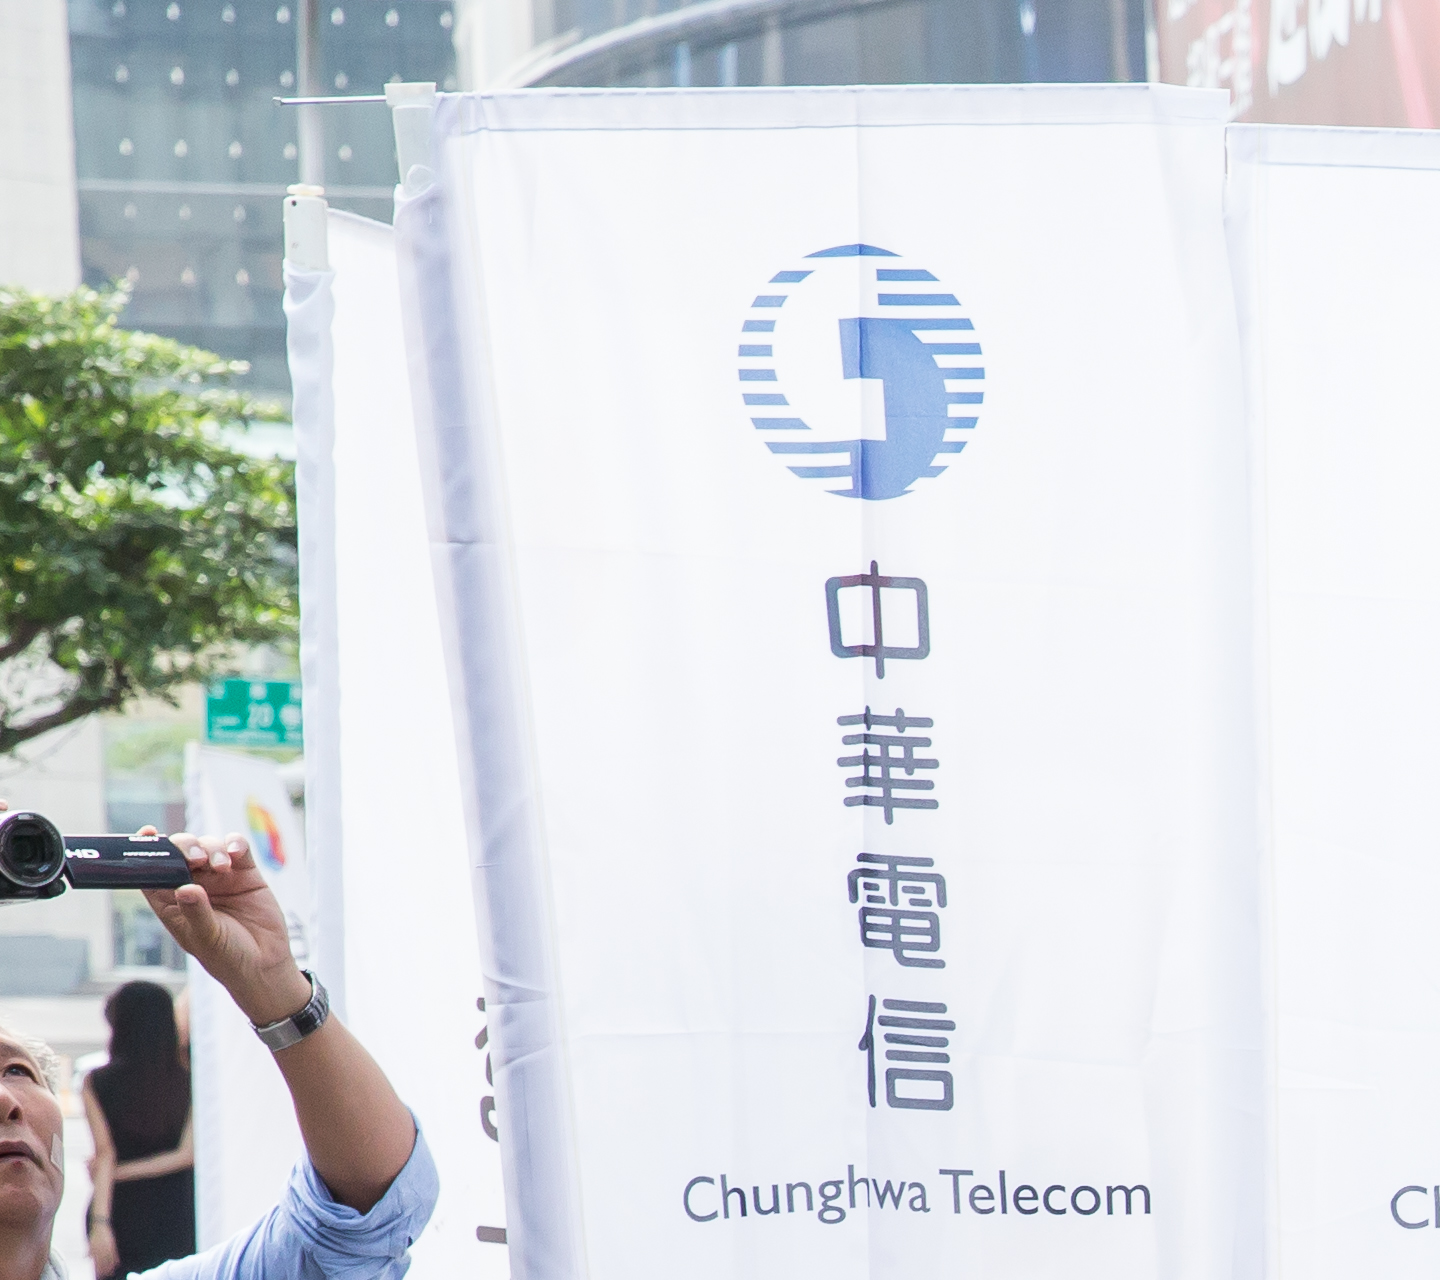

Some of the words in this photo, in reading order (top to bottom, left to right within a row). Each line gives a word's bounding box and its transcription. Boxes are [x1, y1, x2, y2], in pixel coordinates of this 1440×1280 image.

[825, 560, 956, 1111] 中華電信
[684, 1165, 930, 1224] Chunghwa
[939, 1169, 1150, 1215] Telecom
